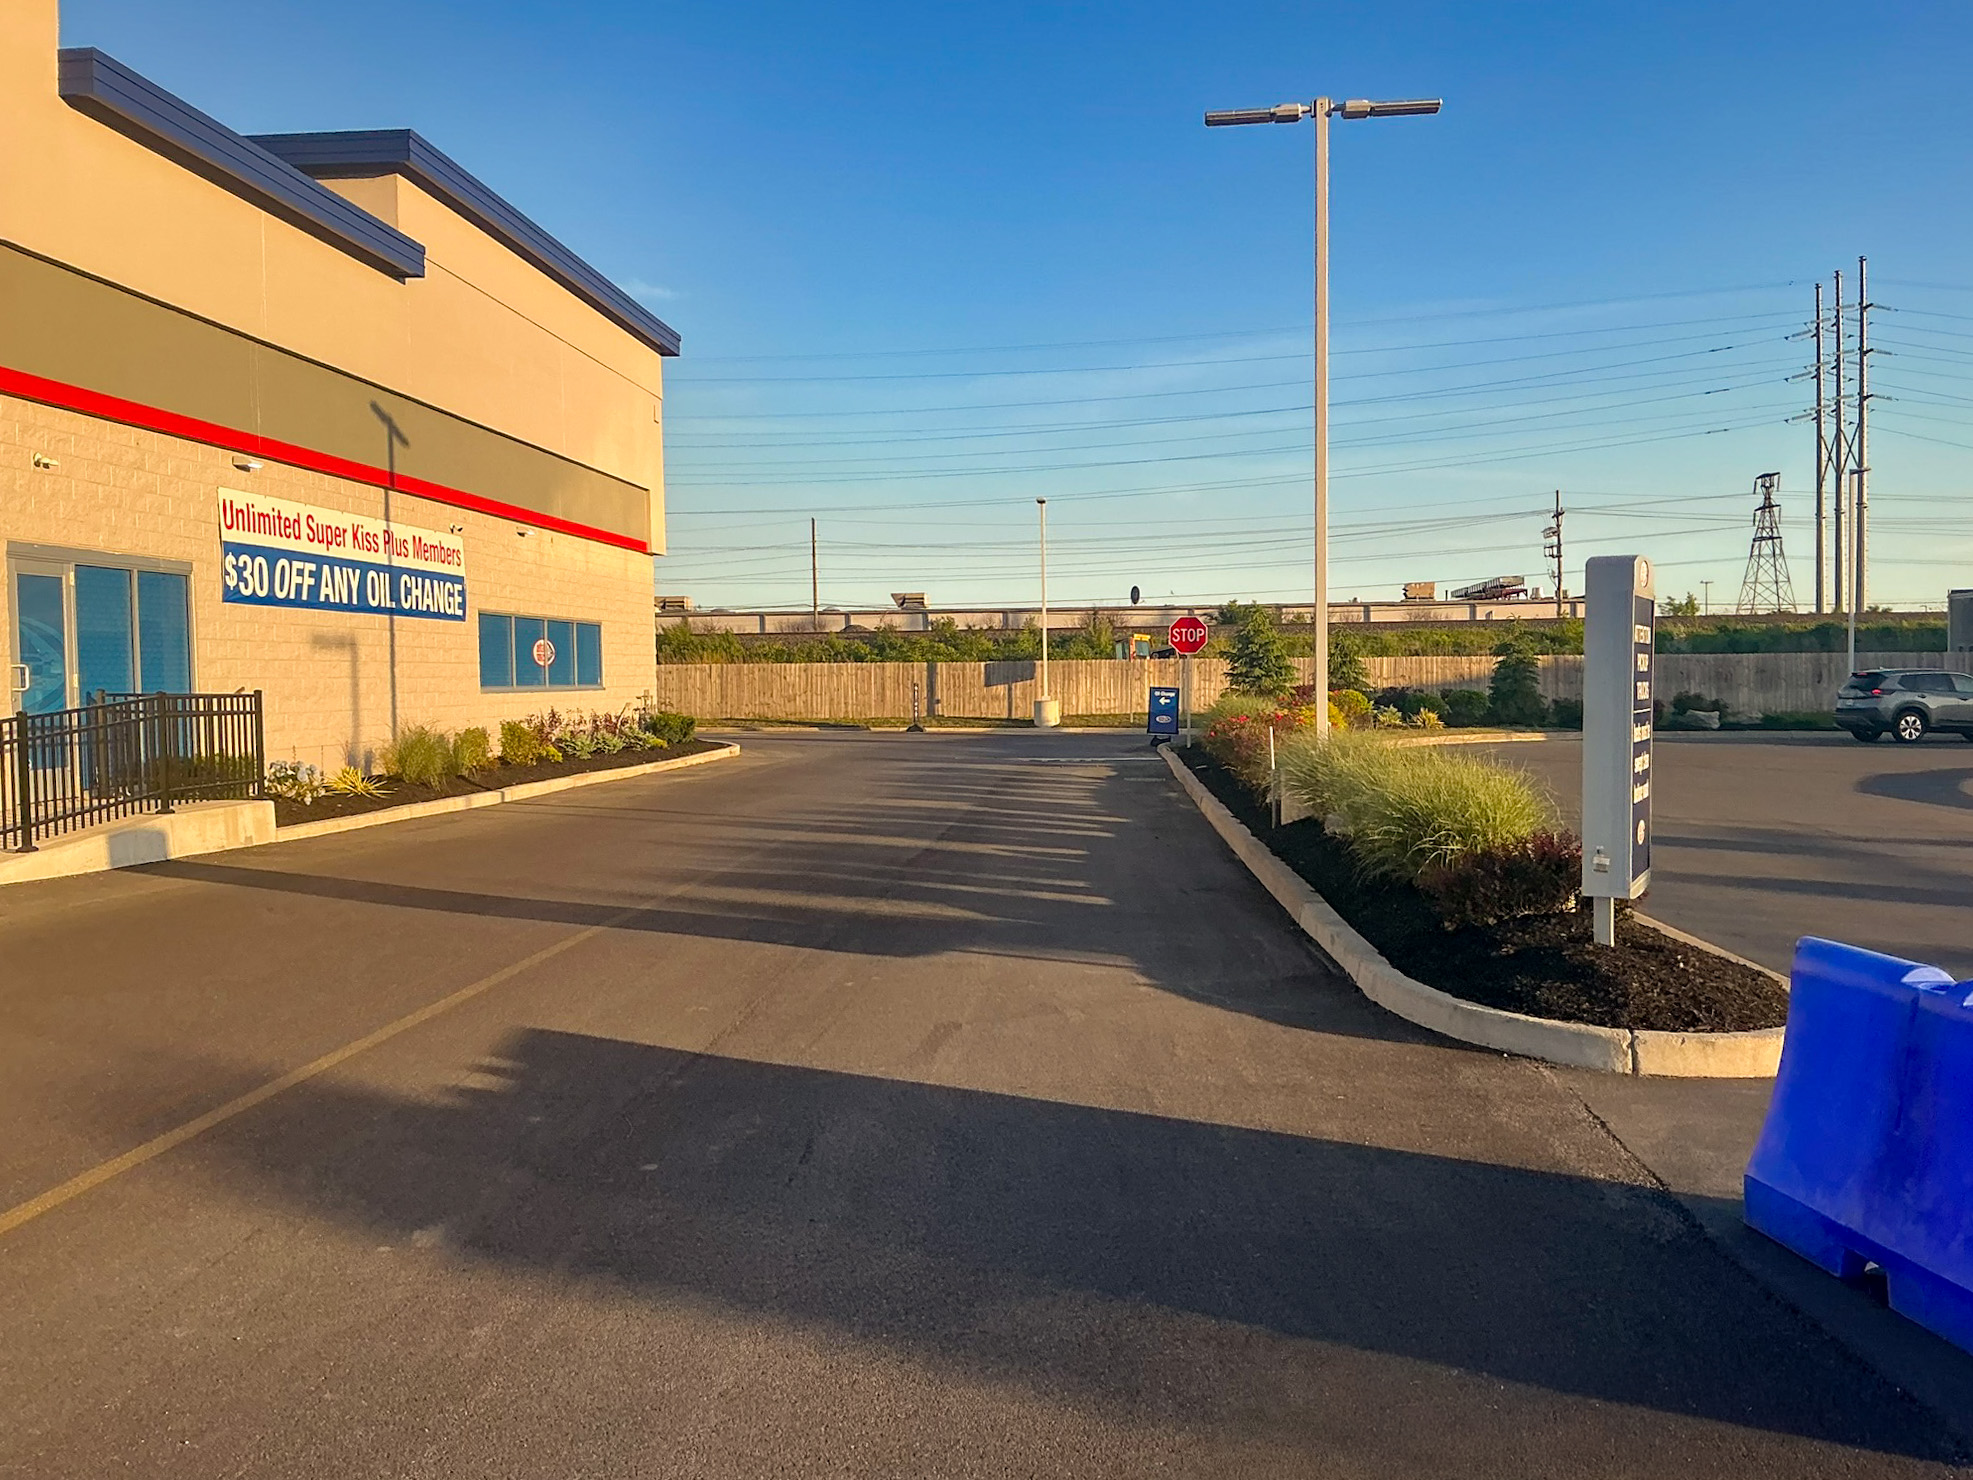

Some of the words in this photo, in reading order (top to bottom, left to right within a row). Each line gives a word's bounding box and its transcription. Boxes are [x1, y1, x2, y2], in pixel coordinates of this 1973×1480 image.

[223, 499, 300, 540] Unlimited
[306, 514, 347, 551] Super
[352, 524, 379, 553] Kiss
[383, 531, 409, 558] Plus
[413, 535, 462, 567] Members
[224, 552, 269, 598] $30
[274, 558, 317, 601] OFF
[319, 564, 361, 605] ANY
[366, 570, 396, 608] OIL
[400, 573, 463, 616] CHANGE
[1172, 628, 1205, 642] STOP
